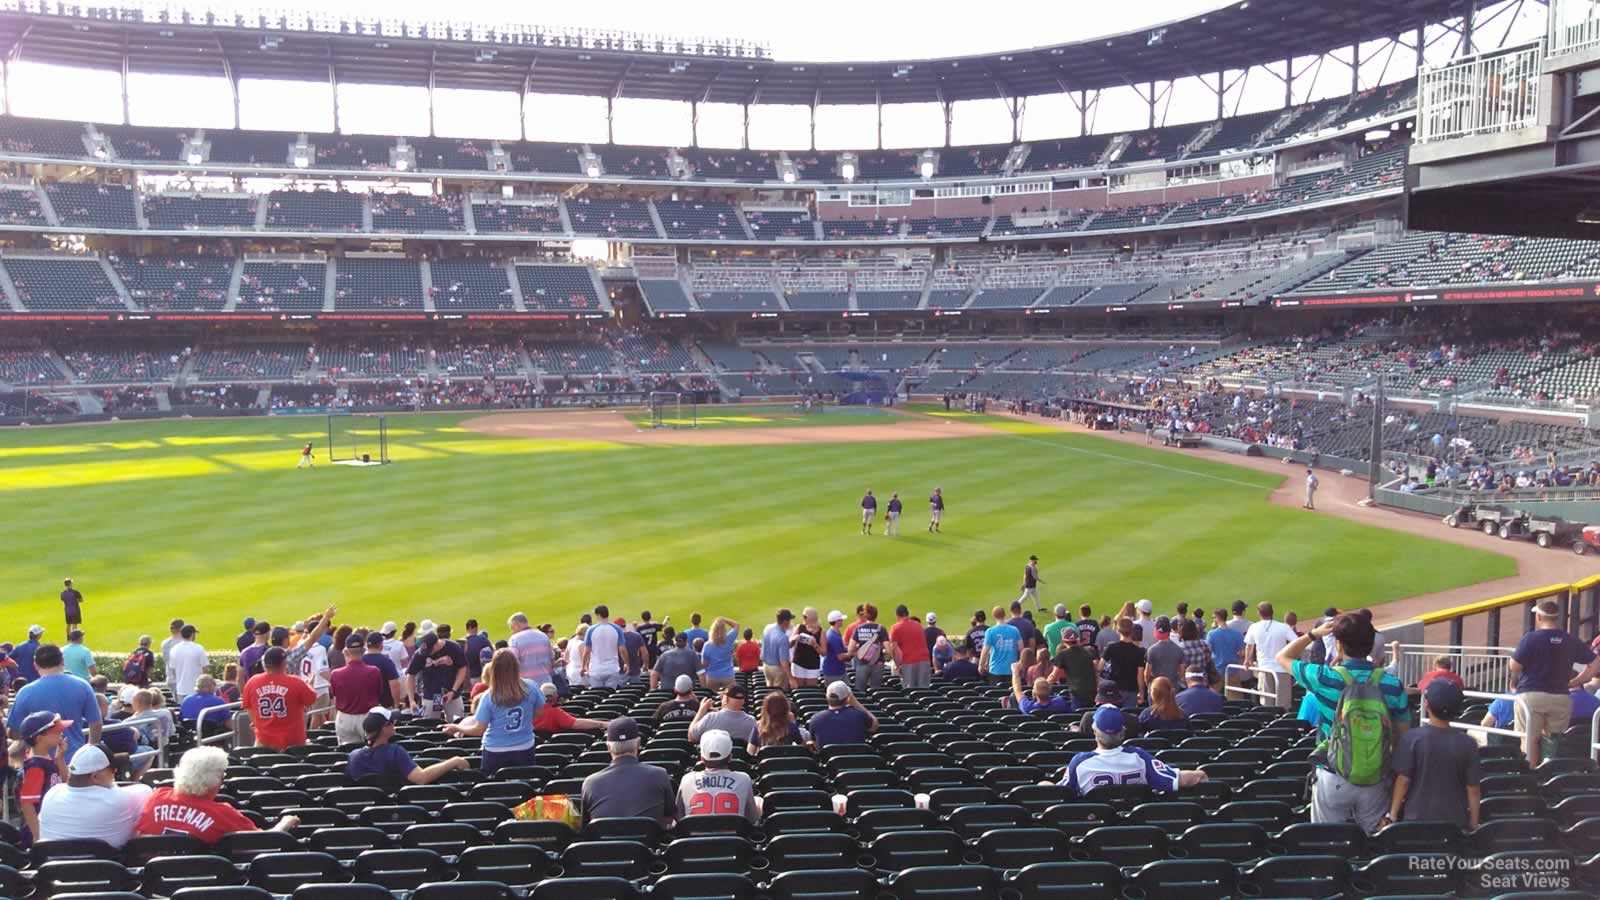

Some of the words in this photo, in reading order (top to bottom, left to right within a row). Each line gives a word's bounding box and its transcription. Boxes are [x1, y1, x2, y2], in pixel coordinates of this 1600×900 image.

[258, 696, 288, 719] 24
[504, 705, 524, 732] 3
[695, 775, 736, 790] SMOLTZ
[153, 804, 215, 833] FREEMAN
